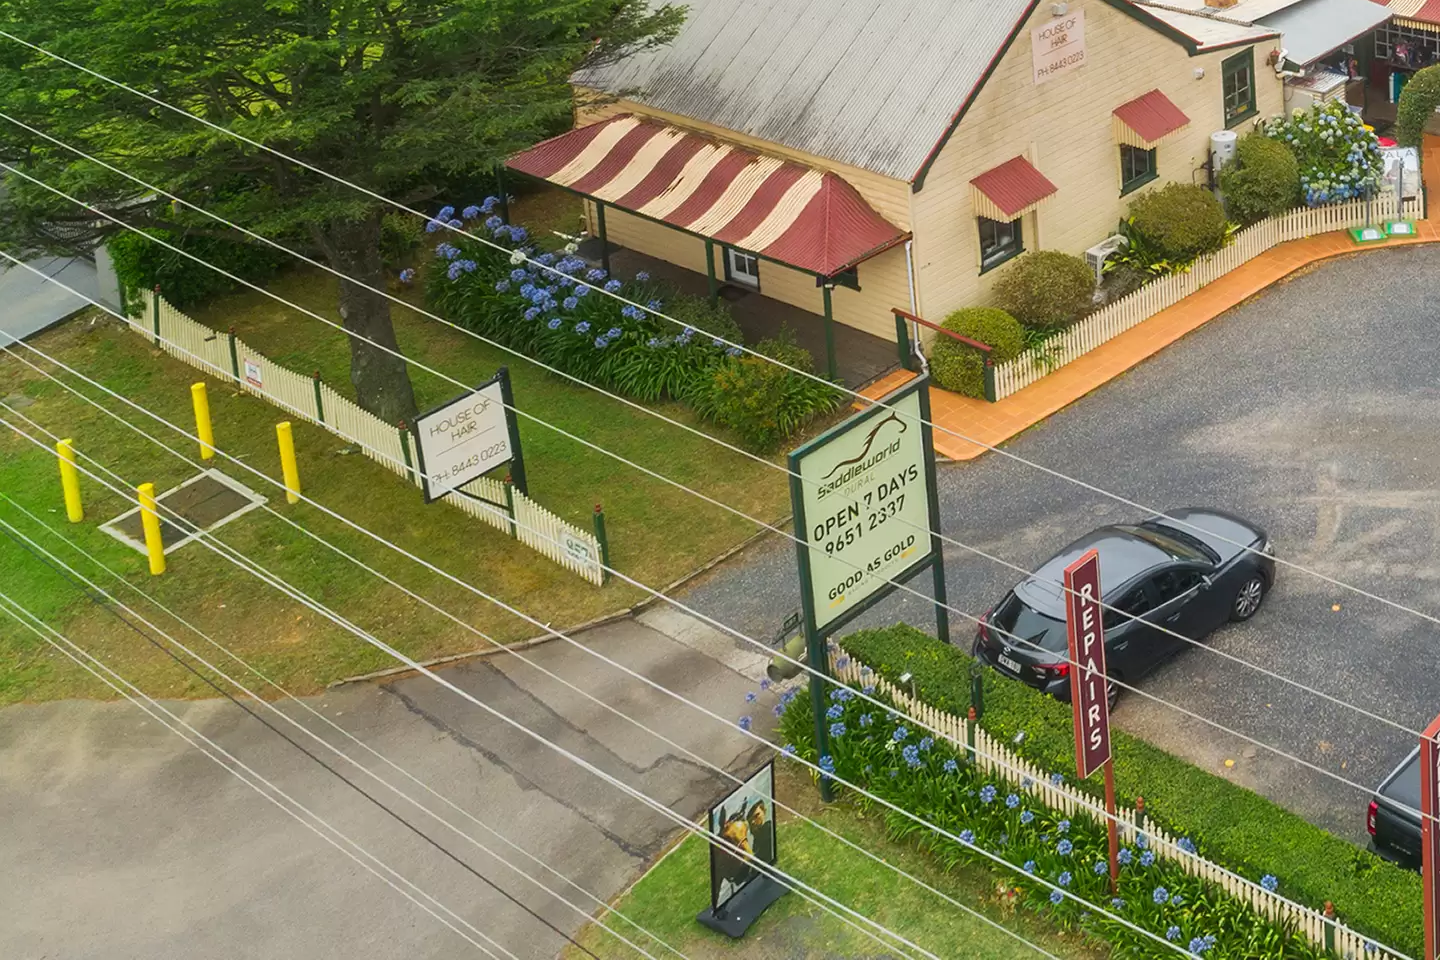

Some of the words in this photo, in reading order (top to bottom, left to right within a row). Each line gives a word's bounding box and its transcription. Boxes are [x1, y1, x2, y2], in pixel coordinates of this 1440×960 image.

[1038, 22, 1065, 42] HOUSE
[1065, 17, 1076, 30] OF
[1050, 34, 1068, 49] HAIR
[429, 409, 472, 437] HOUSE
[473, 398, 491, 416] OF
[451, 420, 477, 442] HAIR
[452, 454, 479, 477] 8443
[480, 440, 507, 461] 0223
[818, 438, 901, 500] Saddleworld
[814, 500, 859, 542] OPEN
[863, 491, 872, 510] 7
[877, 464, 918, 502] DAYS
[825, 523, 863, 559] 9651
[869, 494, 906, 531] 2337
[828, 571, 863, 600] GOOD
[866, 557, 881, 575] AS
[884, 534, 915, 561] GOLD
[1080, 582, 1102, 751] REPAIRS
